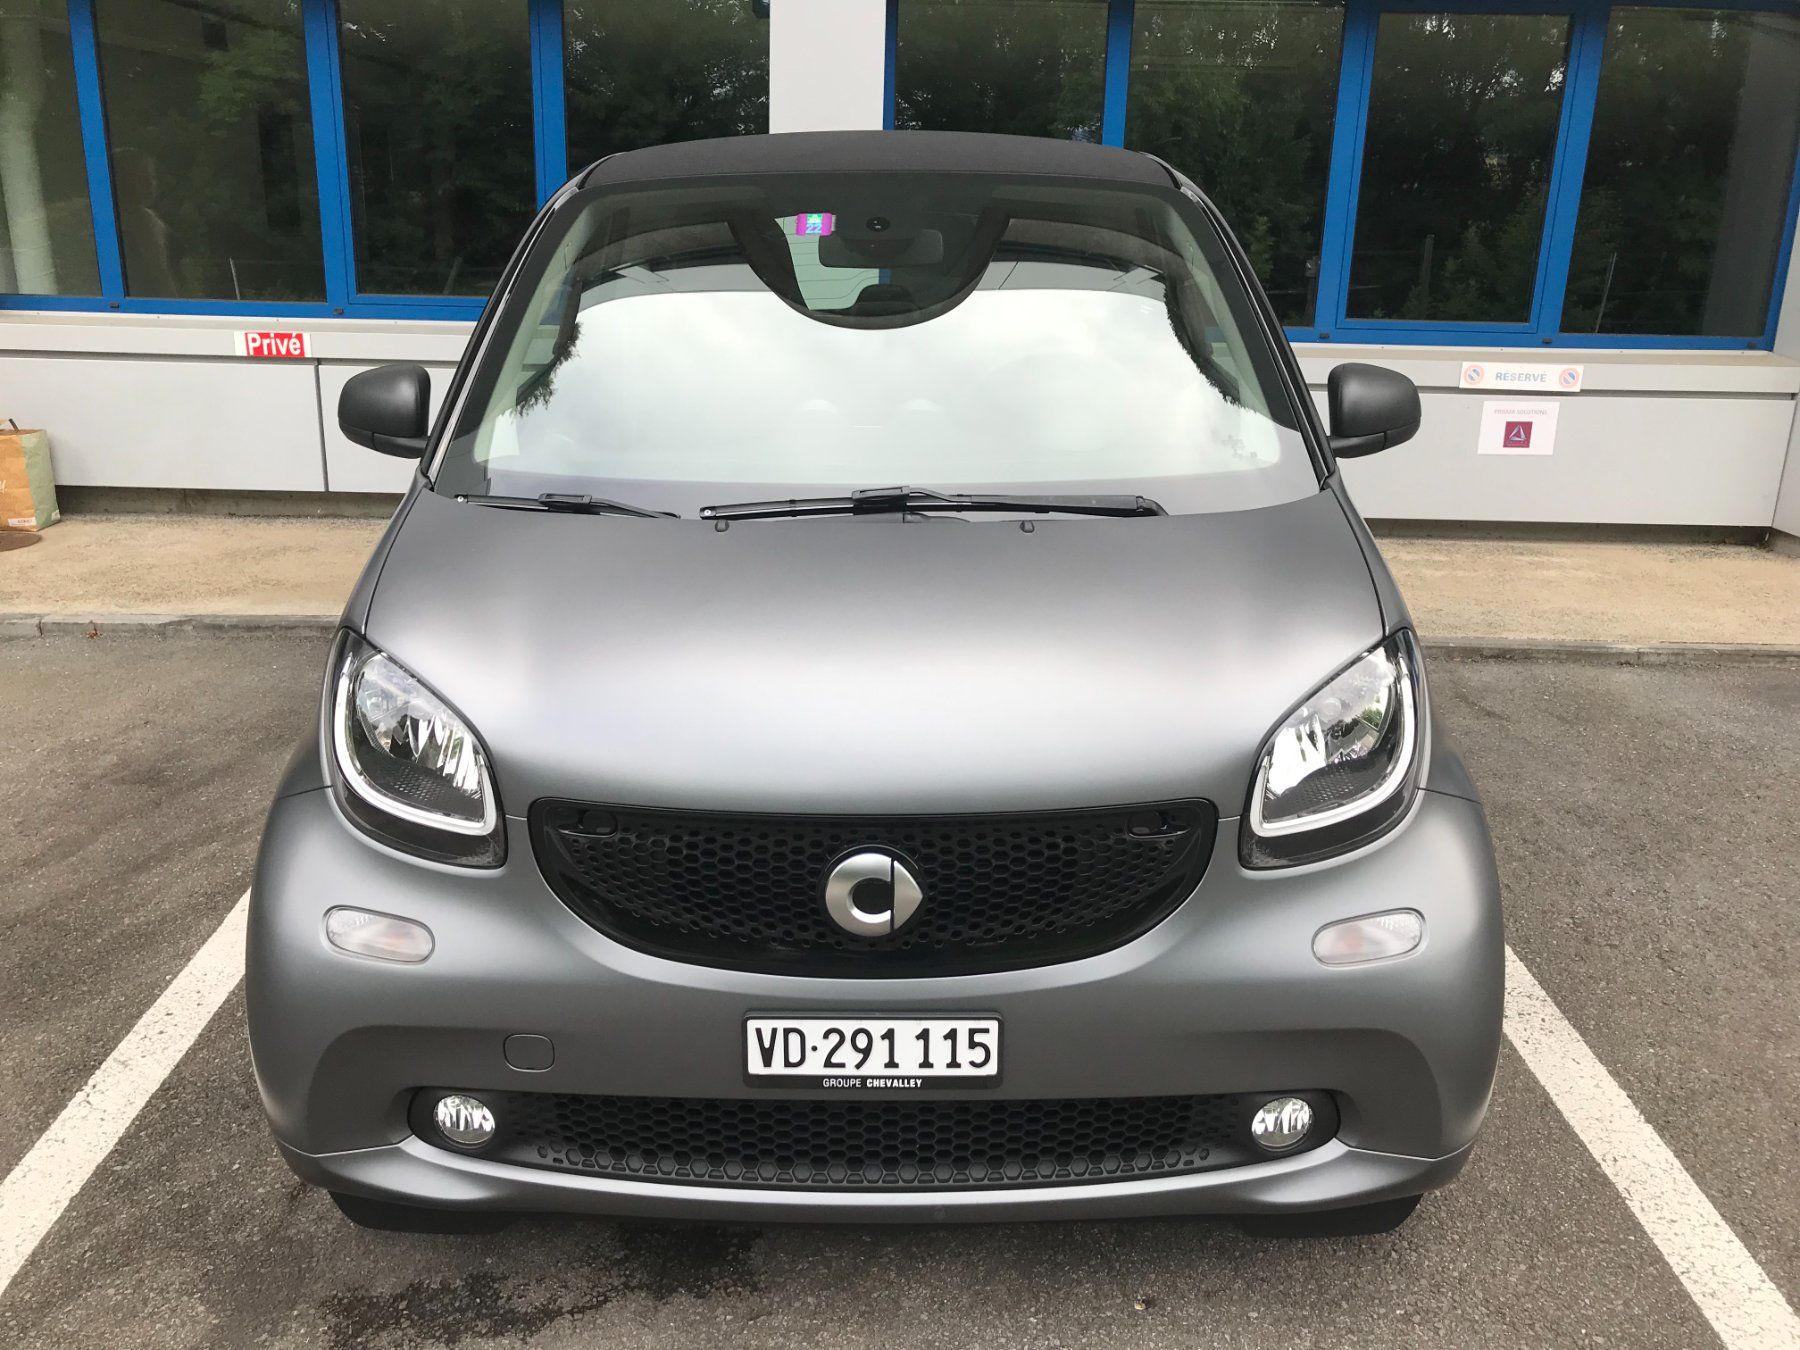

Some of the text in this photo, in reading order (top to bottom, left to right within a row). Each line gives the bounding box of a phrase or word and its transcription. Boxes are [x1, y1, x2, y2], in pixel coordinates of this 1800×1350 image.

[247, 331, 301, 355] Privé
[915, 1027, 991, 1069] 115
[823, 1078, 922, 1088] GROUPE CHEVALLEY
